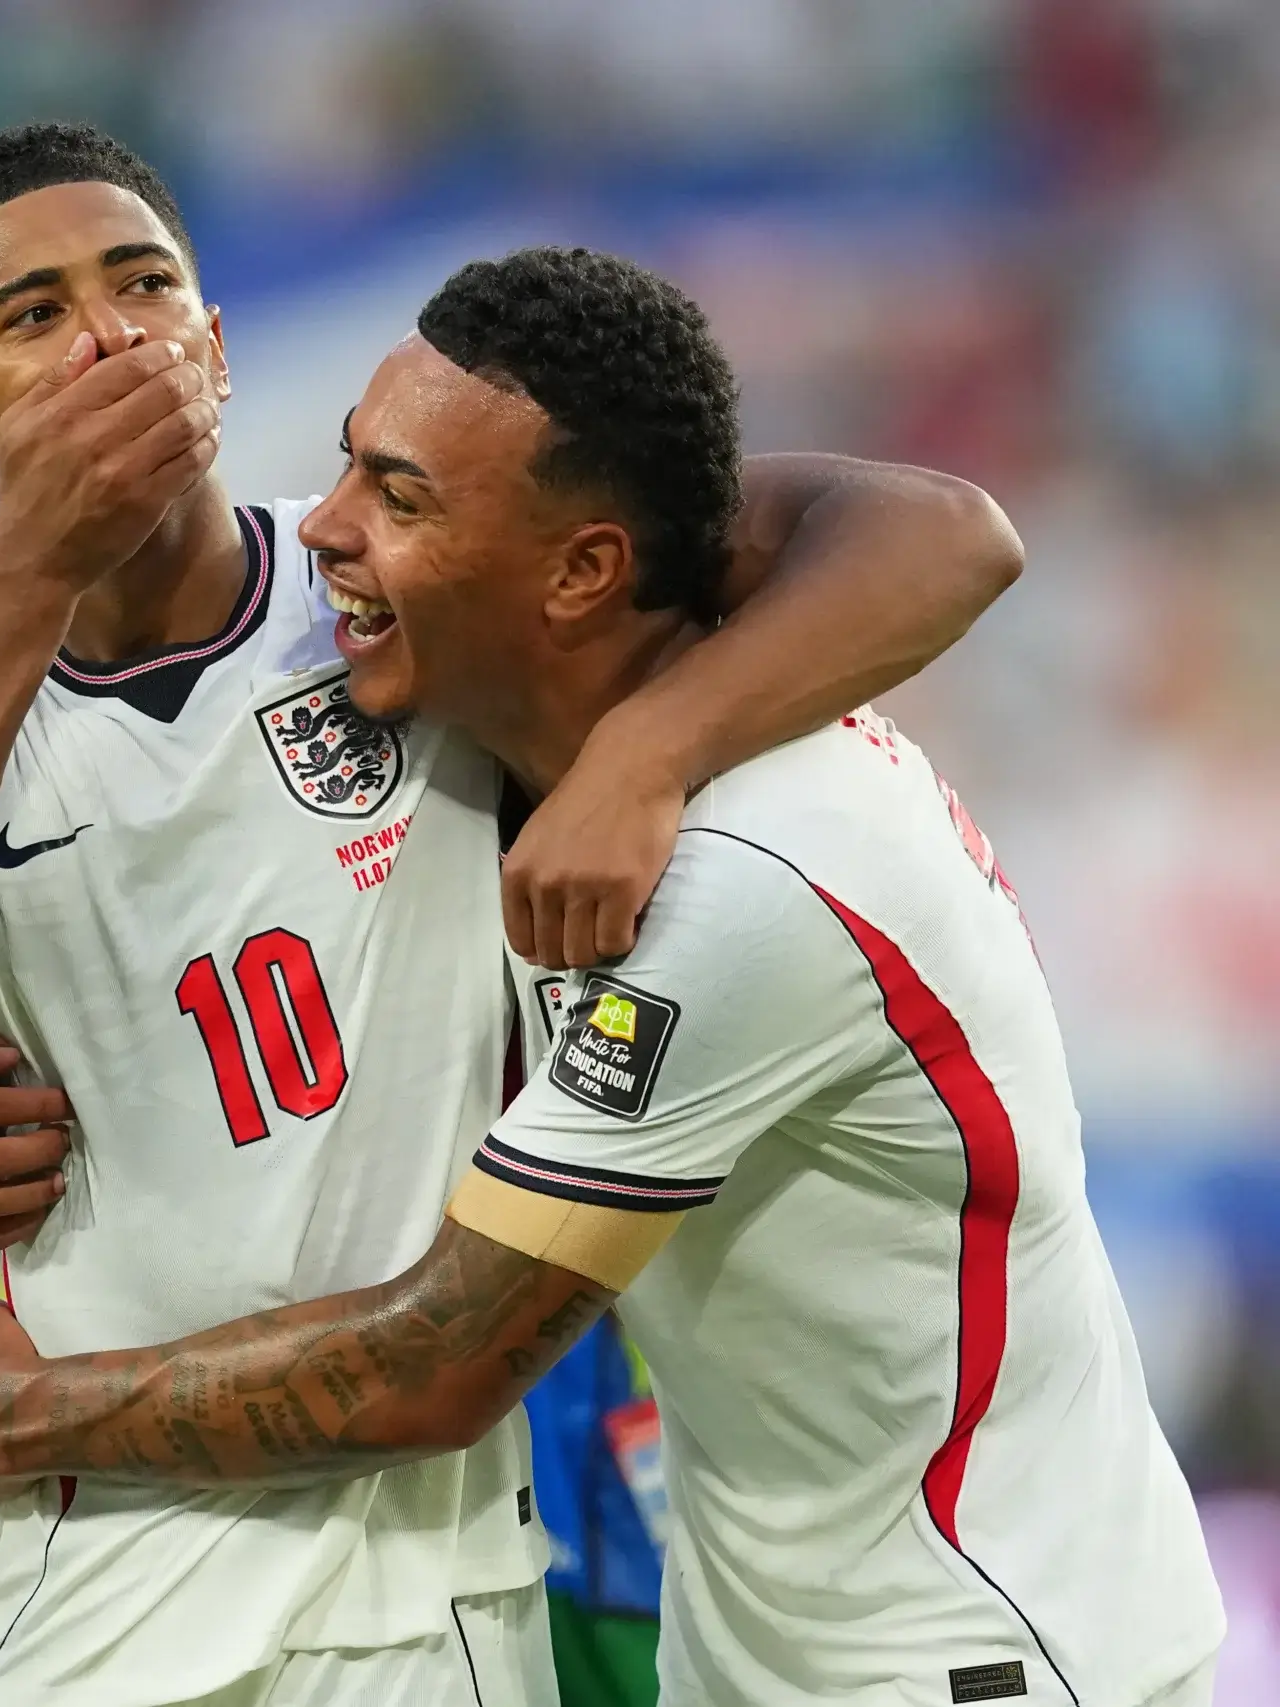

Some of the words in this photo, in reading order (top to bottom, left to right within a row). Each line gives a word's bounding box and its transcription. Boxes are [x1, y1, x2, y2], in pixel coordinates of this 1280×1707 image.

[175, 926, 349, 1148] 10
[578, 1027, 610, 1056] Unite
[610, 1043, 632, 1065] For
[565, 1044, 636, 1092] EDUCATION
[577, 1076, 603, 1096] FIFA
